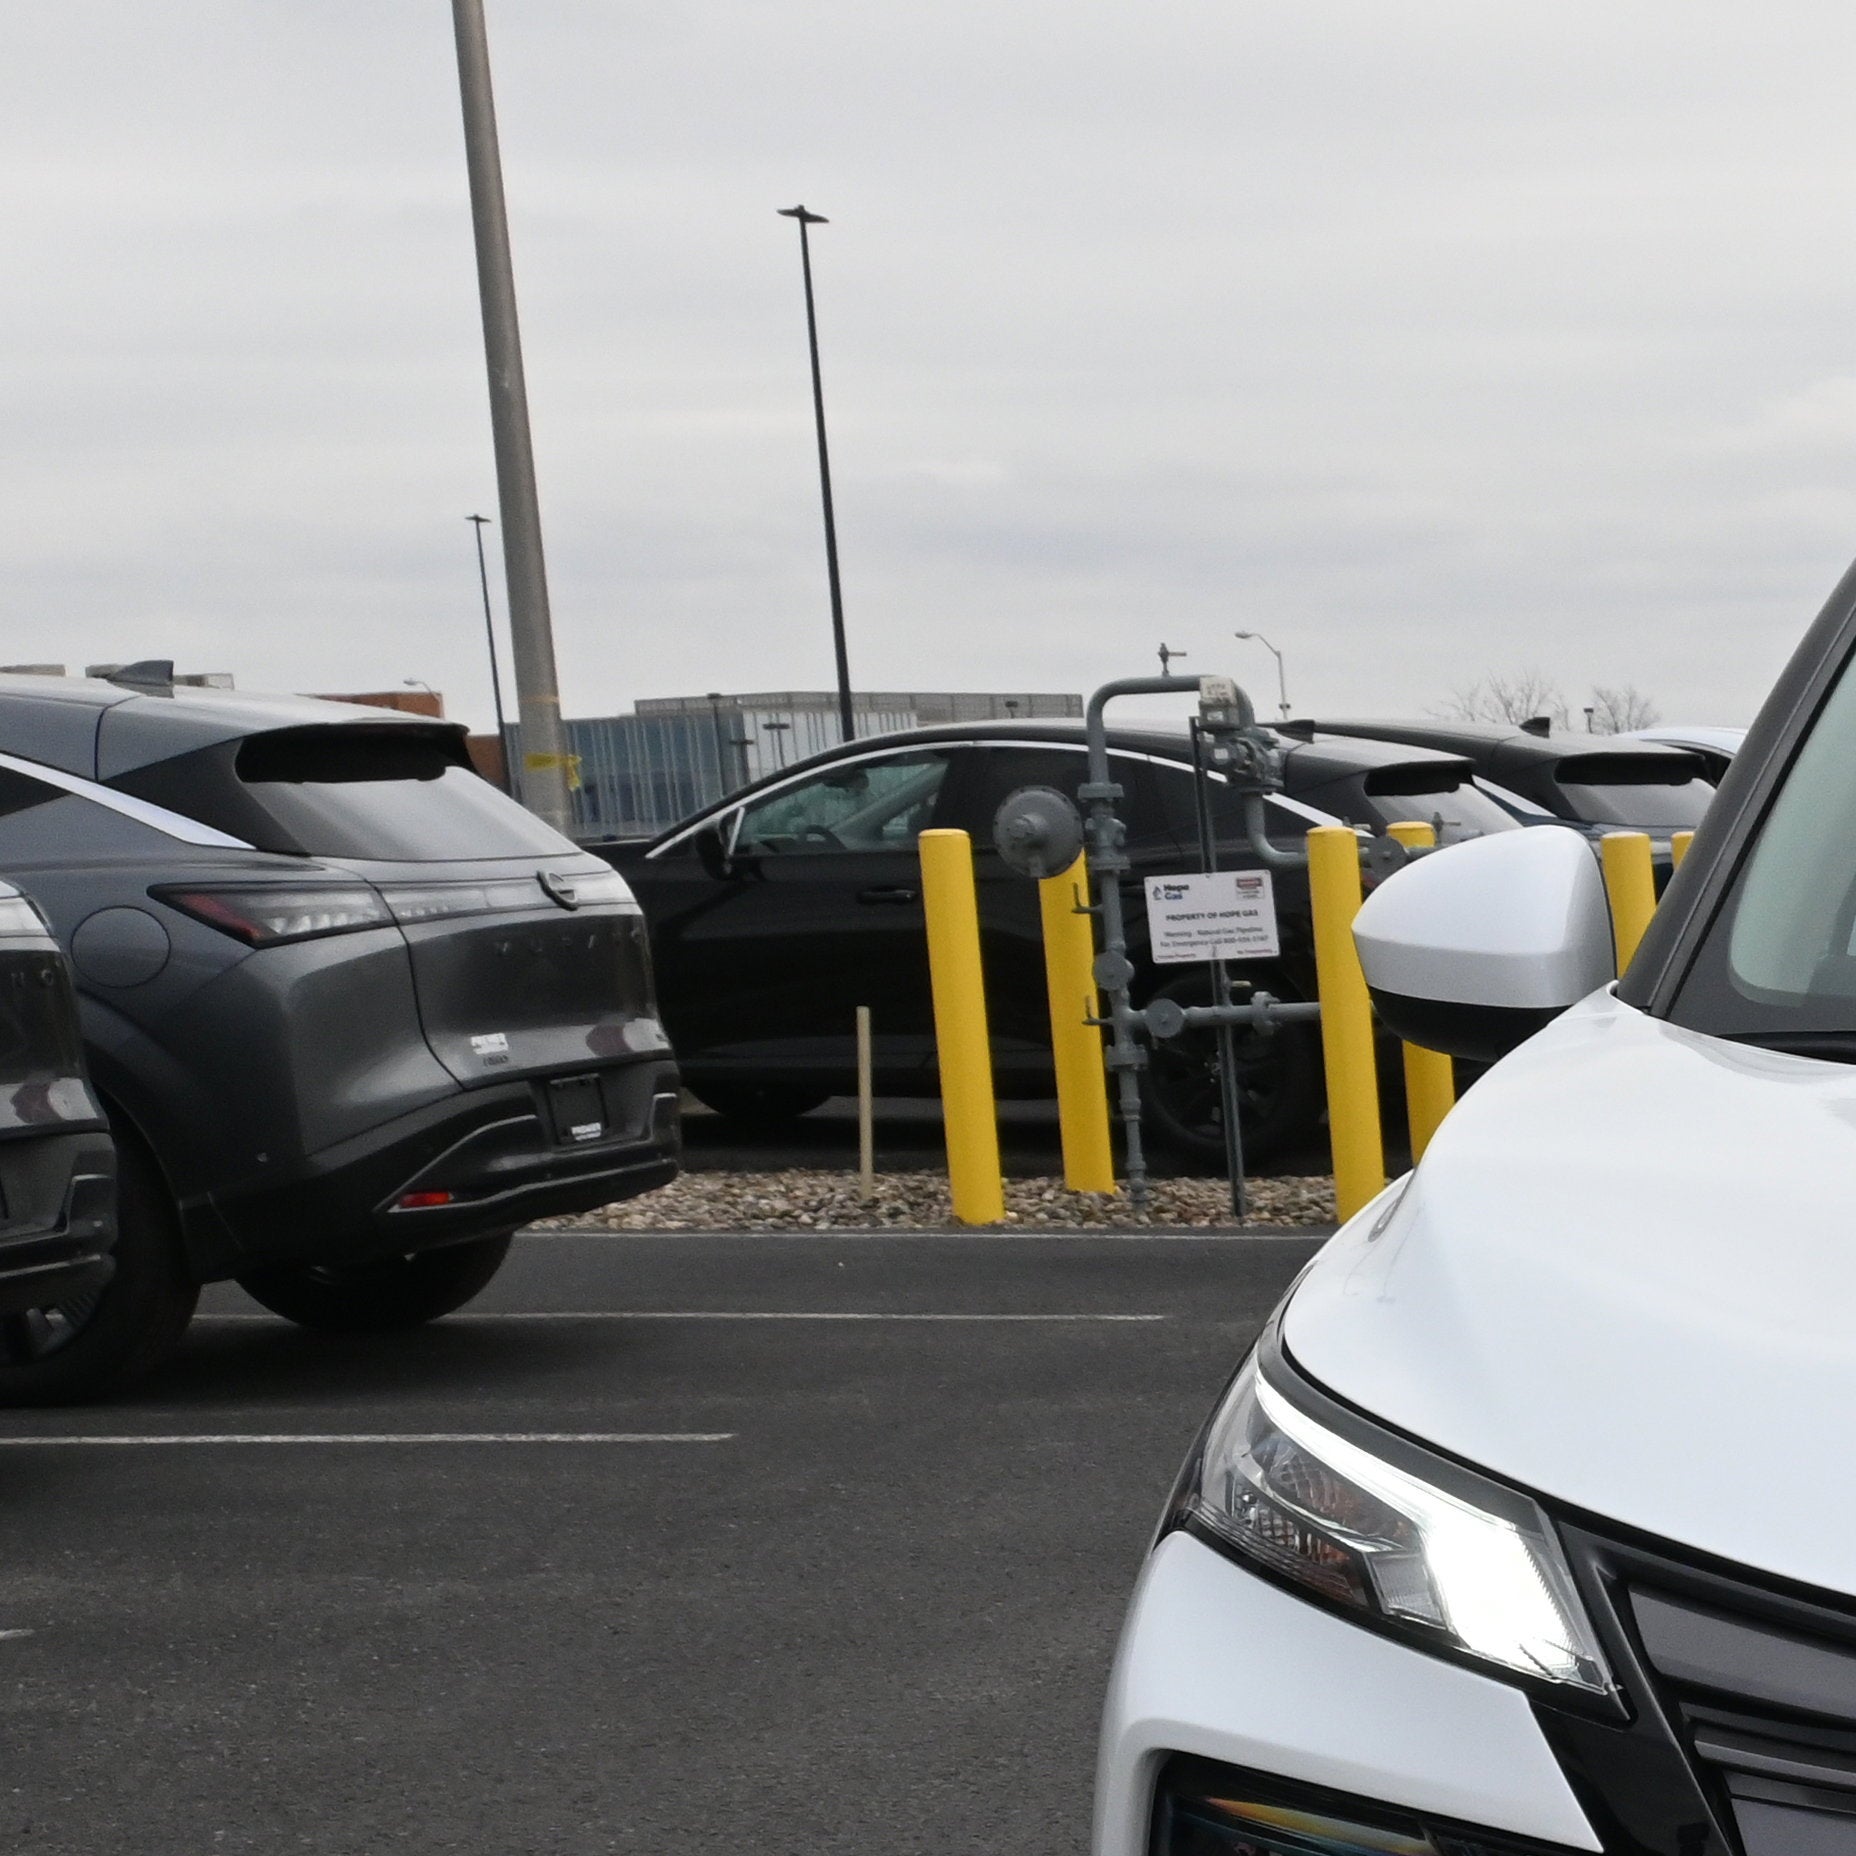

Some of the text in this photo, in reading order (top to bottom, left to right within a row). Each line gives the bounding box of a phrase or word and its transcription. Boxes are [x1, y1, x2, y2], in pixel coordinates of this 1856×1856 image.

[1164, 892, 1183, 900] Gas
[1166, 909, 1259, 921] PROPERTY OF HOPE GAS
